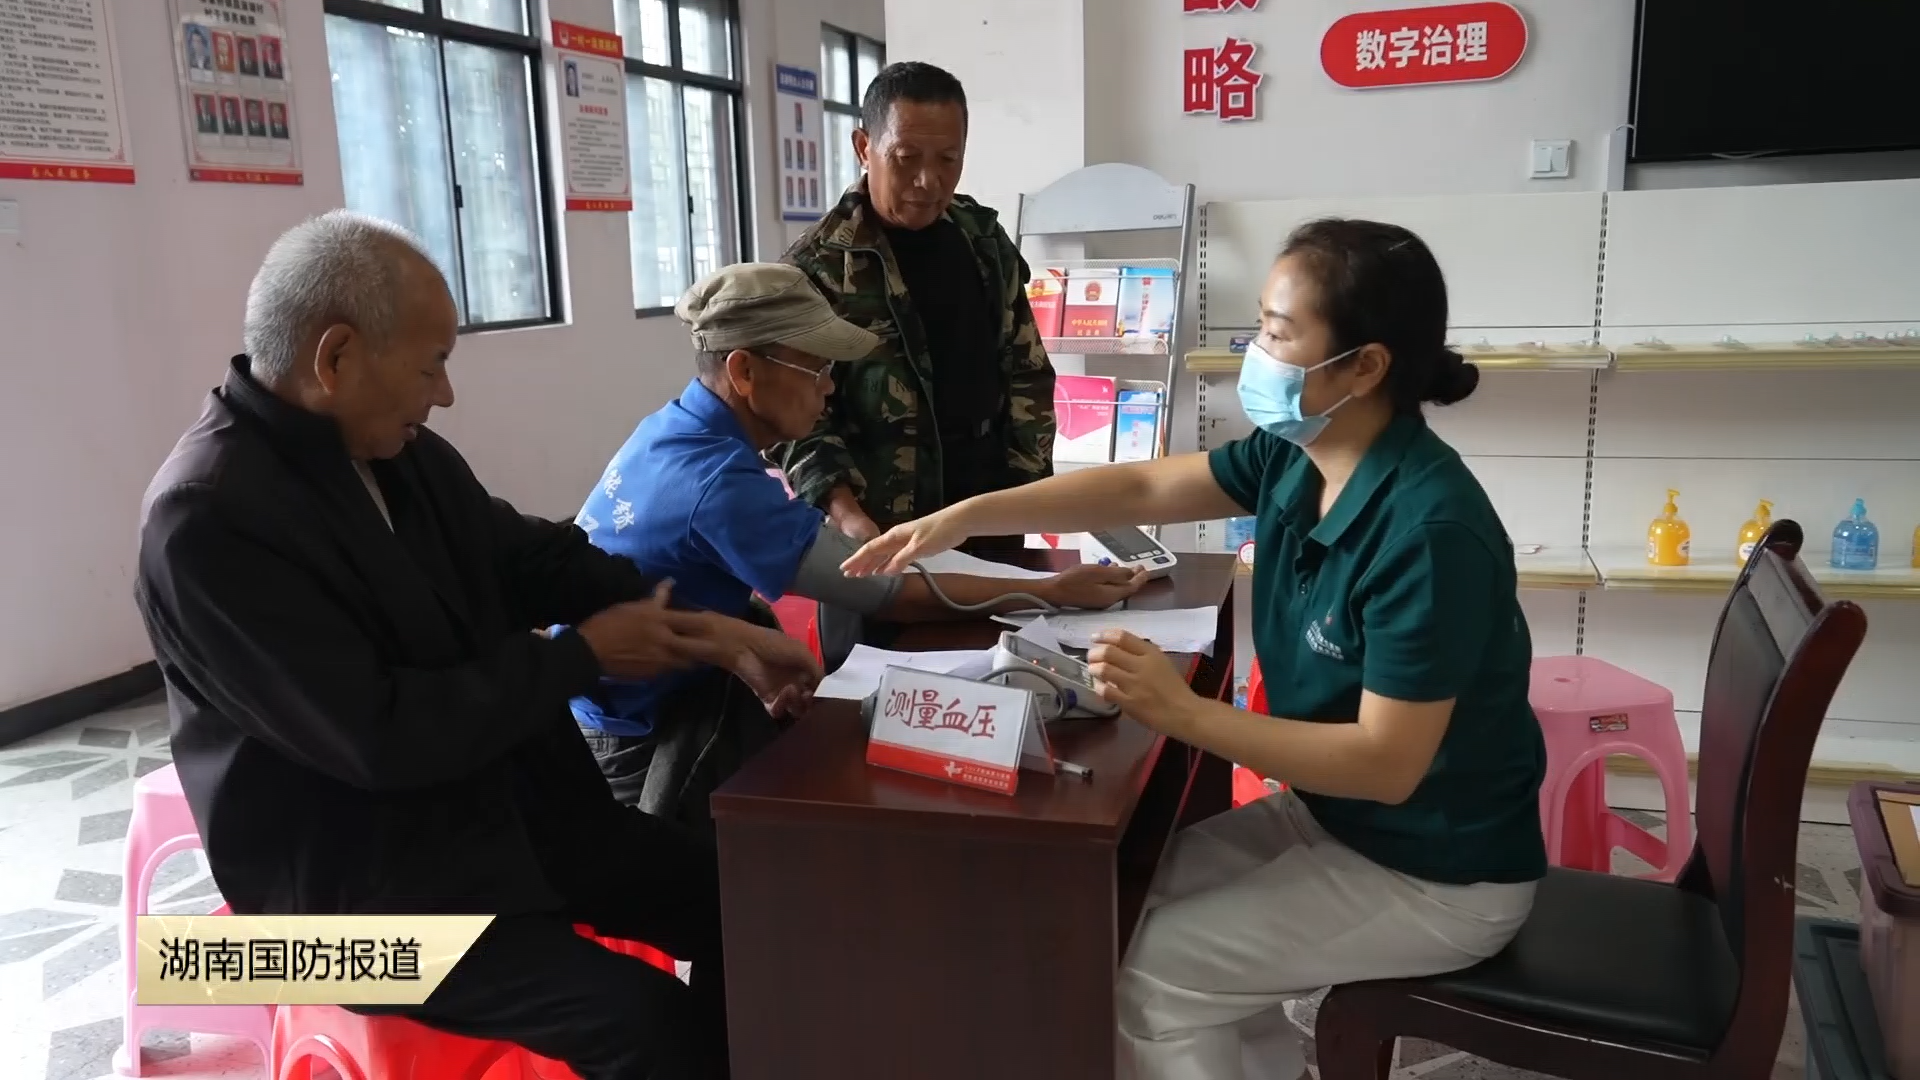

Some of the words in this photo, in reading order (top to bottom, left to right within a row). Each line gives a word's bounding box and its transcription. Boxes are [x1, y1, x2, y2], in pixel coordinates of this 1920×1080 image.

[1183, 0, 1263, 121] 略
[1356, 21, 1488, 71] 数字治理
[884, 688, 997, 739] 测量血压
